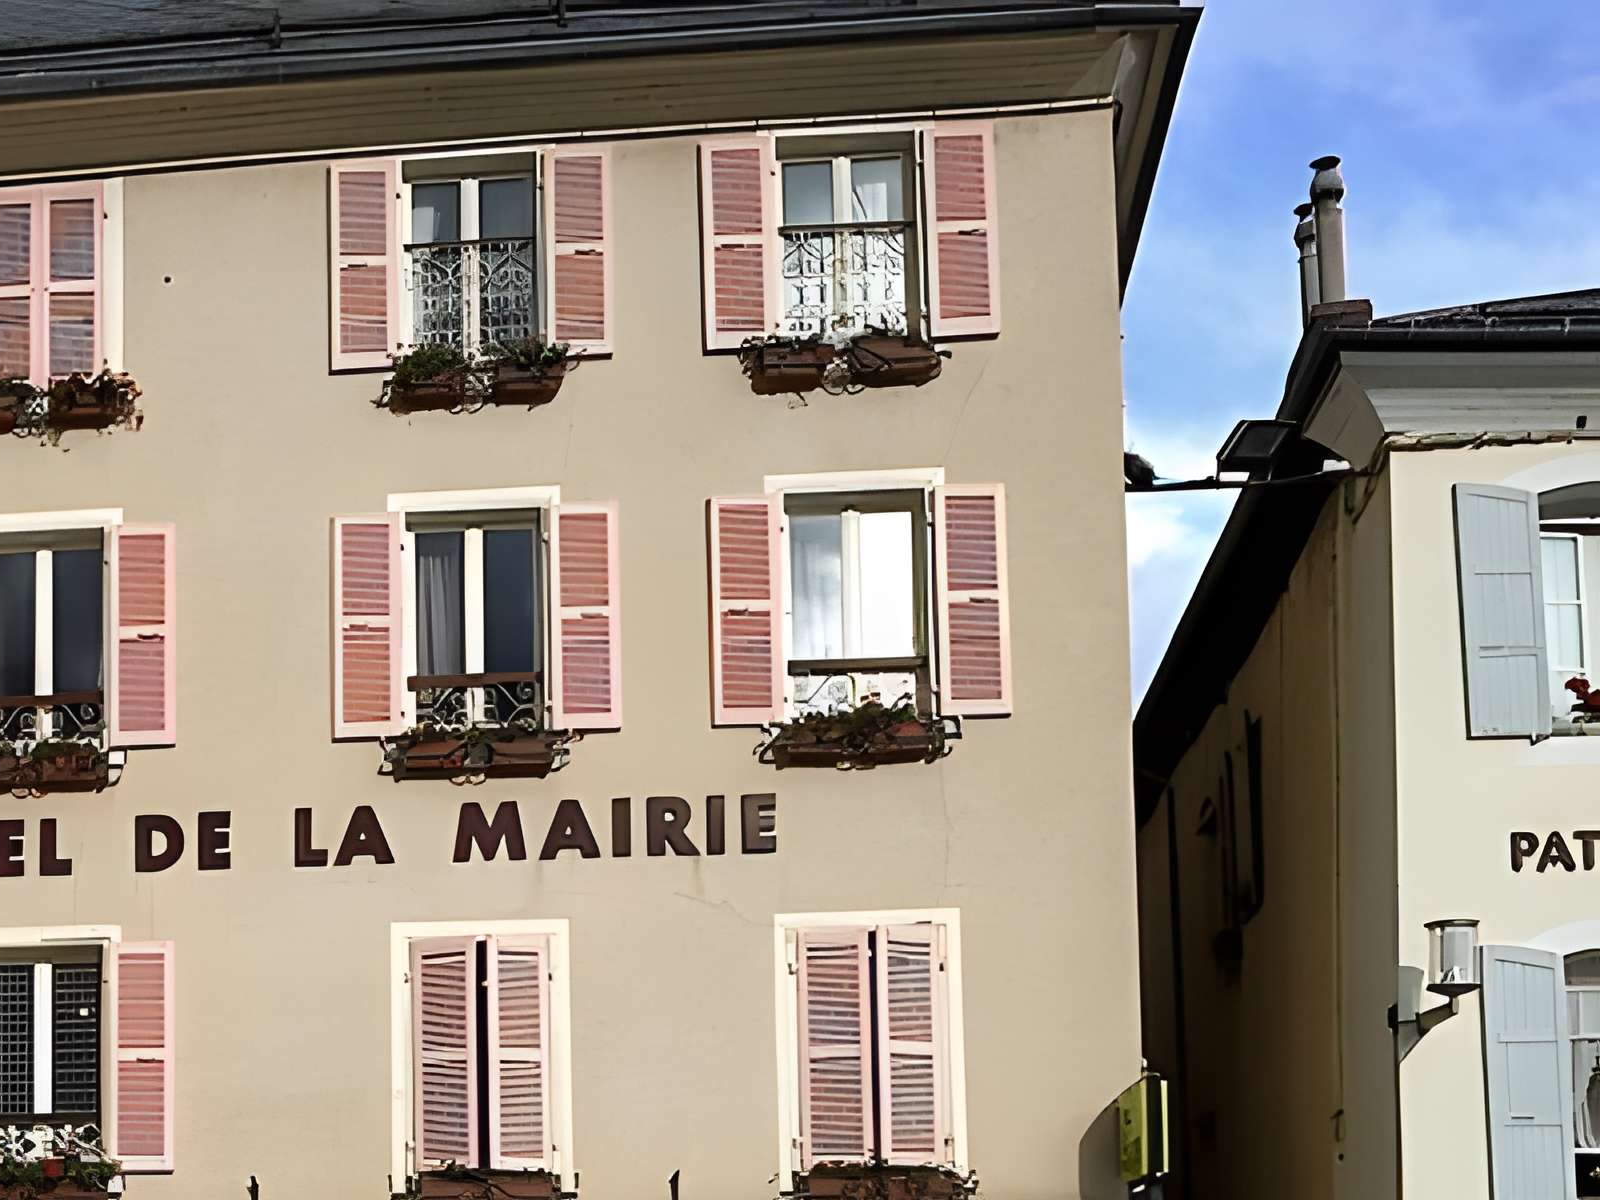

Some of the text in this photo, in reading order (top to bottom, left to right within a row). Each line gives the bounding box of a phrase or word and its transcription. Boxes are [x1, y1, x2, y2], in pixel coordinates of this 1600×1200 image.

[134, 810, 232, 873] DE
[294, 805, 396, 867] LA
[452, 792, 778, 863] MAIRIE
[1510, 830, 1600, 873] PAT
